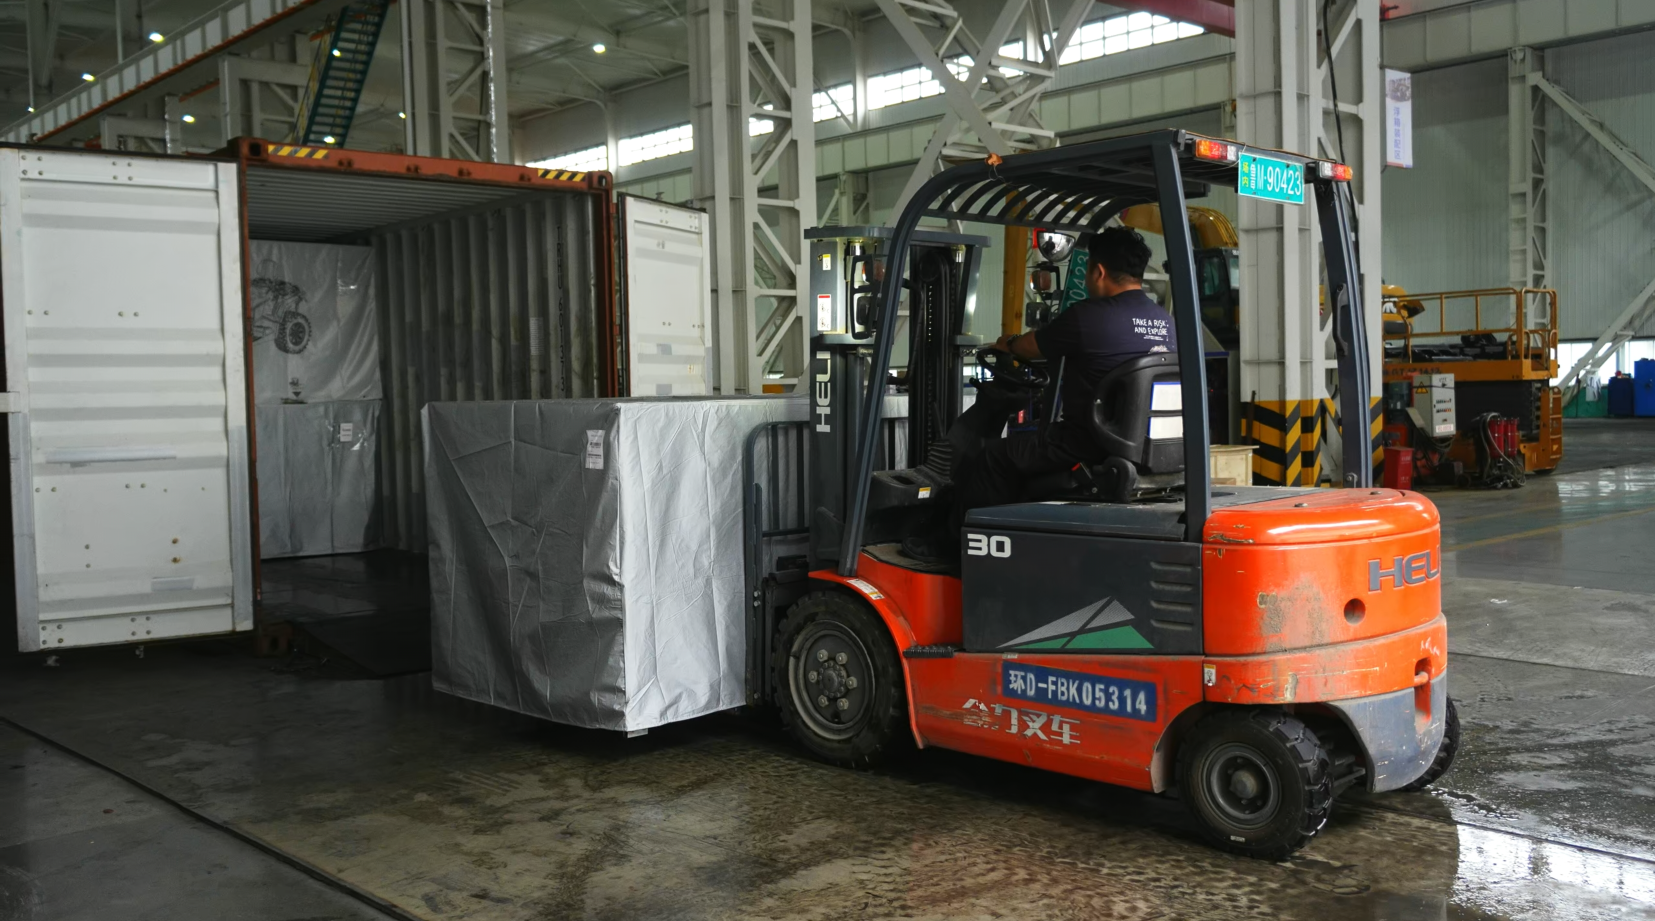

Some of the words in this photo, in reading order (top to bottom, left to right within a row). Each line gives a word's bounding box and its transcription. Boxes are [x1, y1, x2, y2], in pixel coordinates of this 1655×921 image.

[1067, 255, 1089, 307] 0423
[1132, 318, 1147, 327] TAKE
[1148, 319, 1152, 327] A
[816, 350, 831, 433] HELI
[967, 533, 1012, 558] 30
[1008, 669, 1147, 716] 环D-FBK05314
